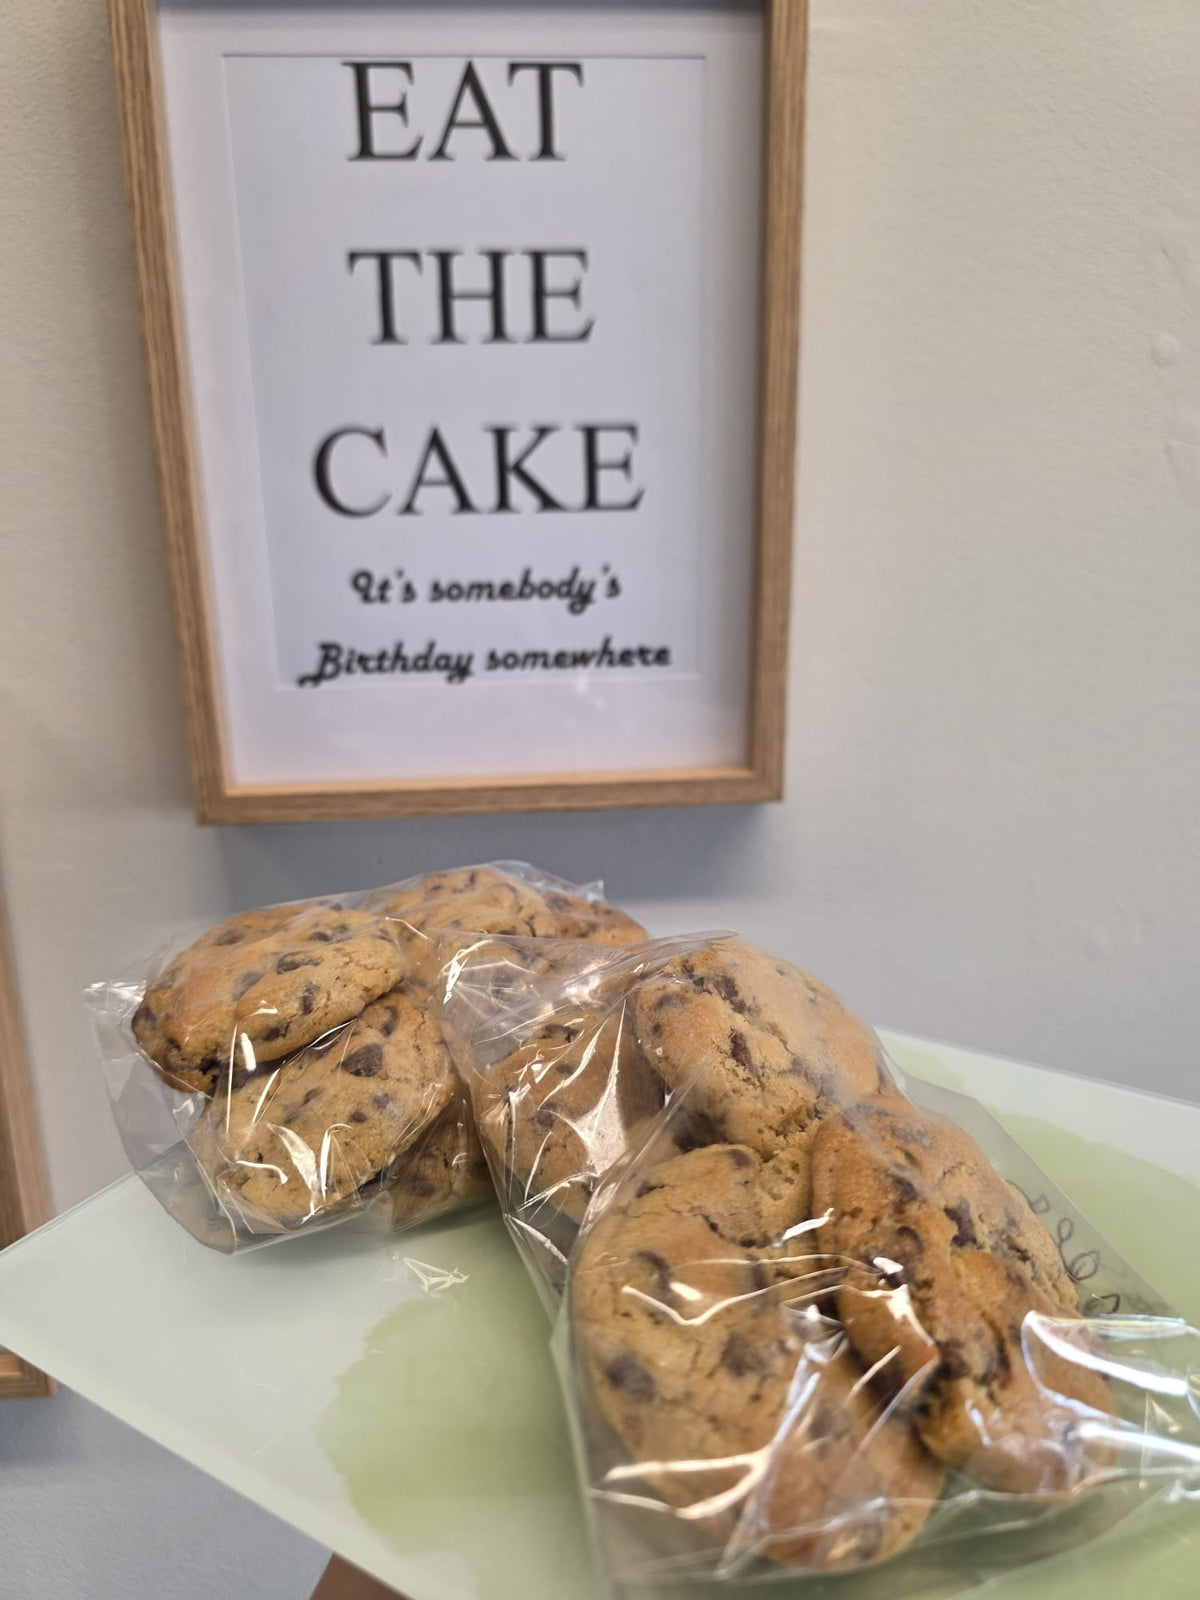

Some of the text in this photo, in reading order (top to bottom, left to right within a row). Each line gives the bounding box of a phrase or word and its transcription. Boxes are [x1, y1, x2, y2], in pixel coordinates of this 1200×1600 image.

[341, 58, 585, 162] EAT
[346, 248, 593, 345] THE
[311, 424, 646, 518] CAKE
[350, 565, 622, 616] It's somebody's
[297, 636, 672, 687] Birthday somewhere
